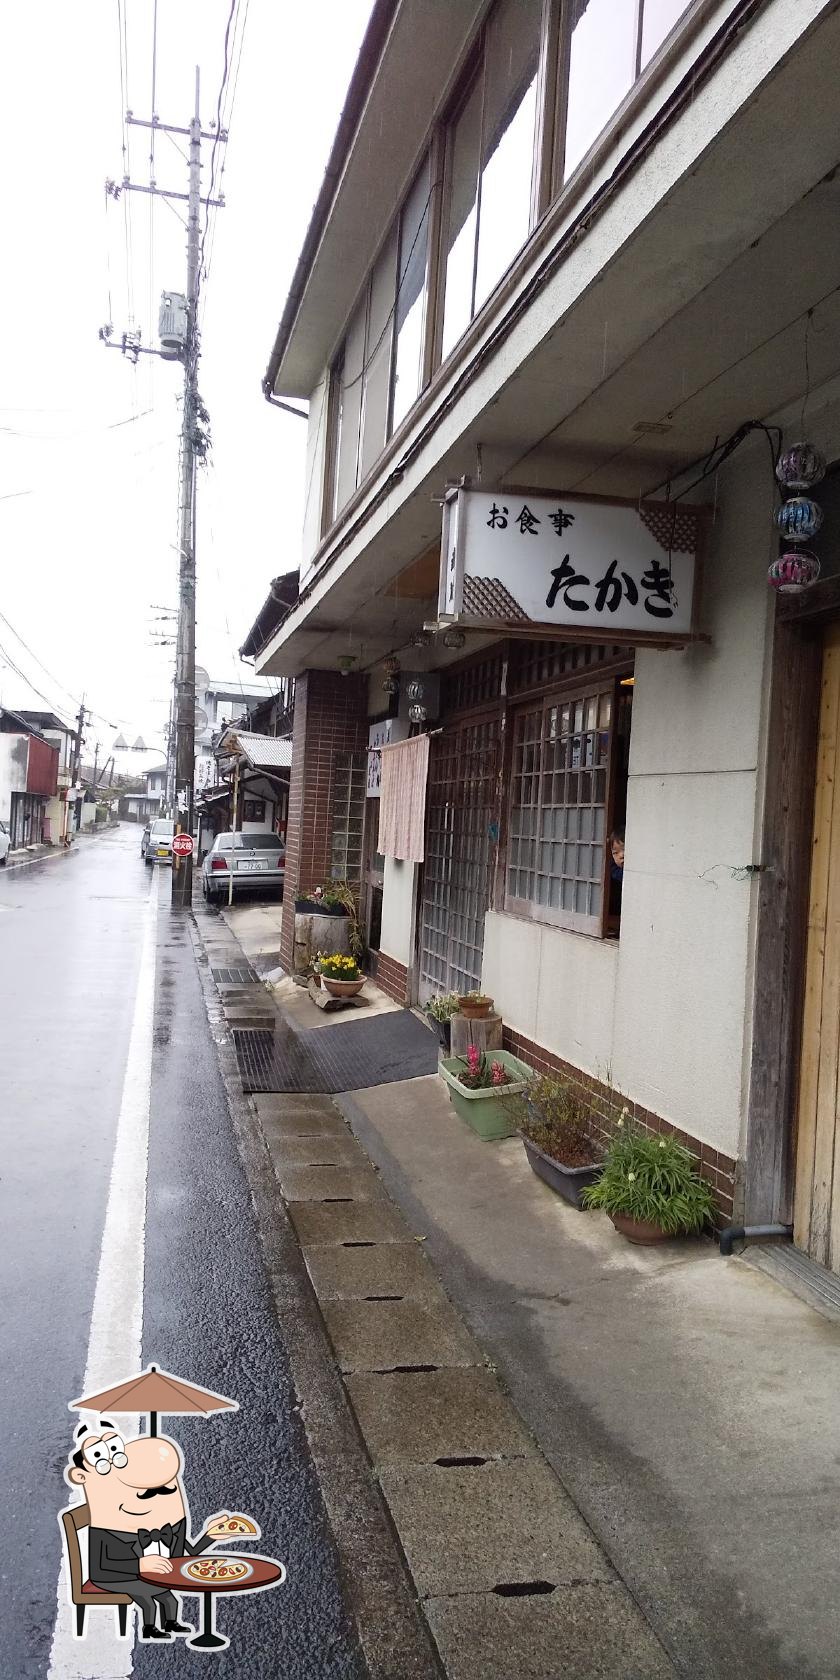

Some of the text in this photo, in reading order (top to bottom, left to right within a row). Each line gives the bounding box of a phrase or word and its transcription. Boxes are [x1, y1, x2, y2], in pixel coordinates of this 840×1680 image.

[487, 503, 575, 536] お食事
[546, 554, 674, 618] たかき
[174, 841, 192, 850] 消火栓
